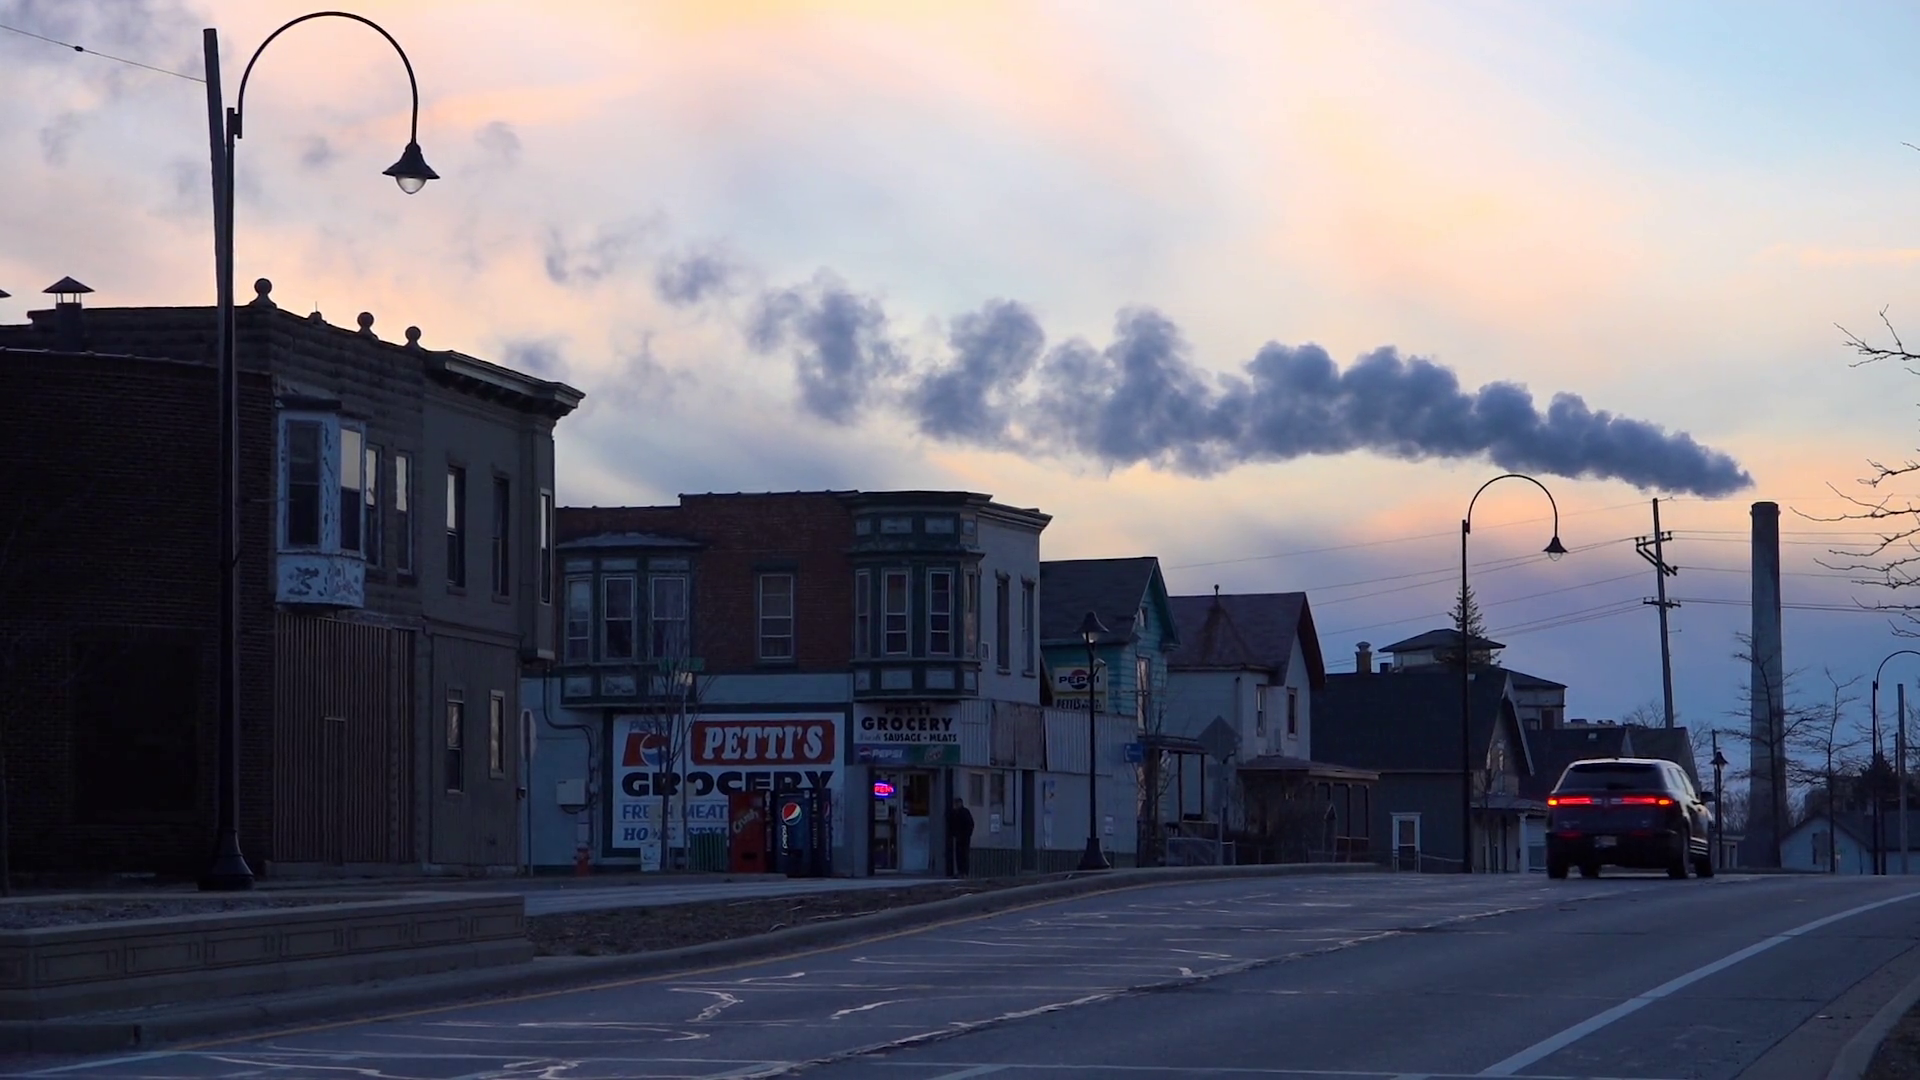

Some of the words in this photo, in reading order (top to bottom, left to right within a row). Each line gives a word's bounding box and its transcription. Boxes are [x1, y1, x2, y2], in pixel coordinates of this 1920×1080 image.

[1058, 676, 1099, 684] PEPI
[861, 716, 953, 731] GROCERY
[702, 726, 824, 761] PETTI'S
[883, 733, 921, 742] SAUSAGE
[929, 733, 957, 742] MEATS
[872, 749, 904, 758] PEPSI
[621, 771, 835, 797] GROCERY
